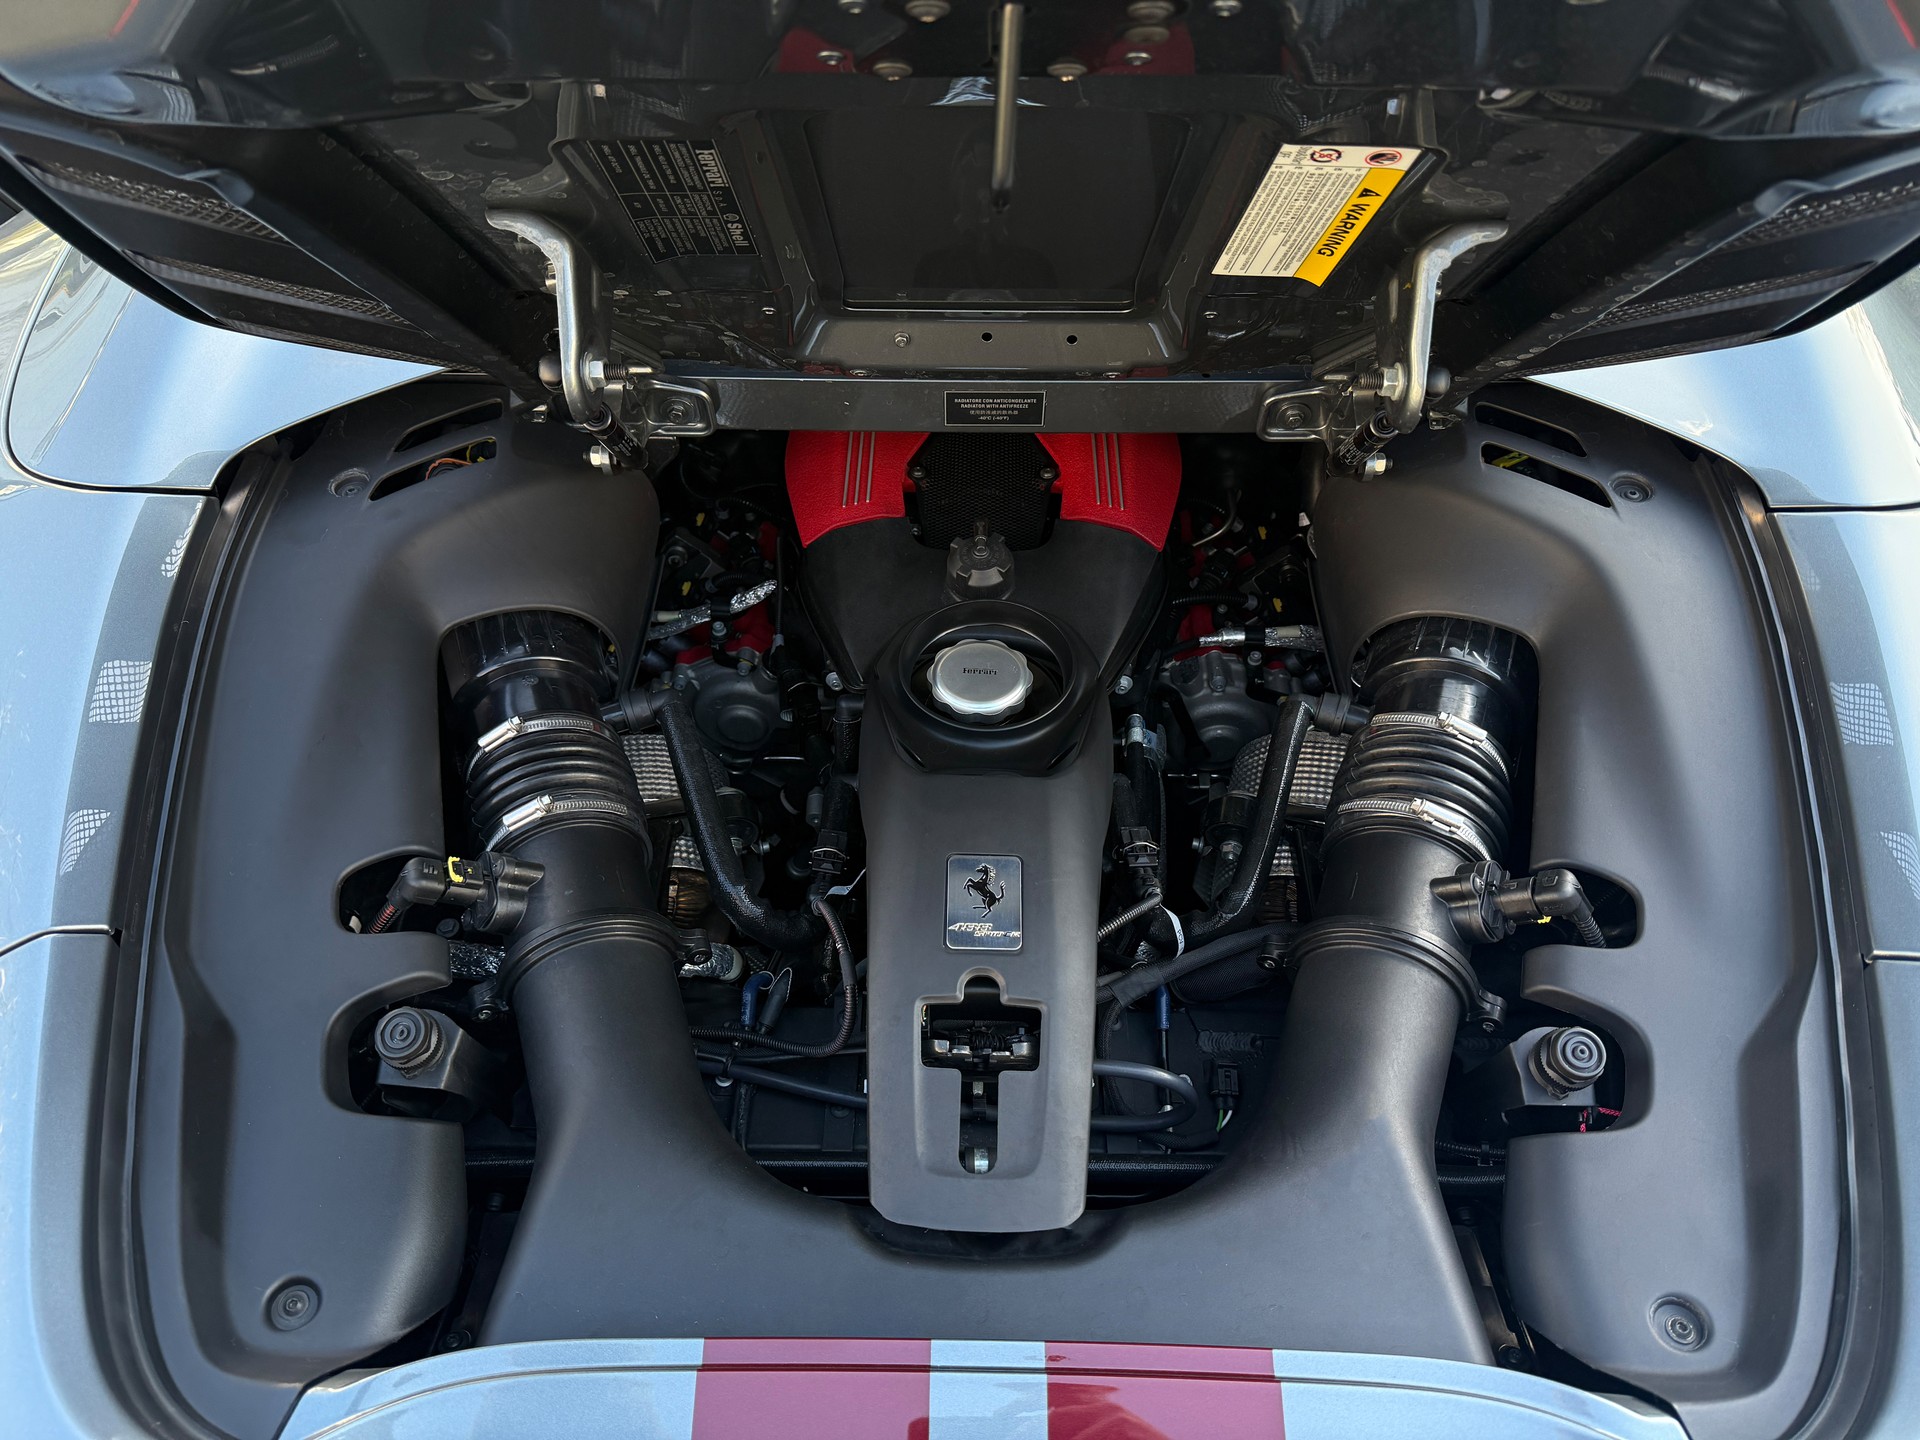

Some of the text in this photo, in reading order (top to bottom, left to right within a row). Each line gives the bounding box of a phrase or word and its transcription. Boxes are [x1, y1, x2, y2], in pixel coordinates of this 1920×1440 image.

[693, 149, 728, 187] Ferrari
[725, 222, 749, 246] Shell
[1316, 203, 1370, 257] WARNING
